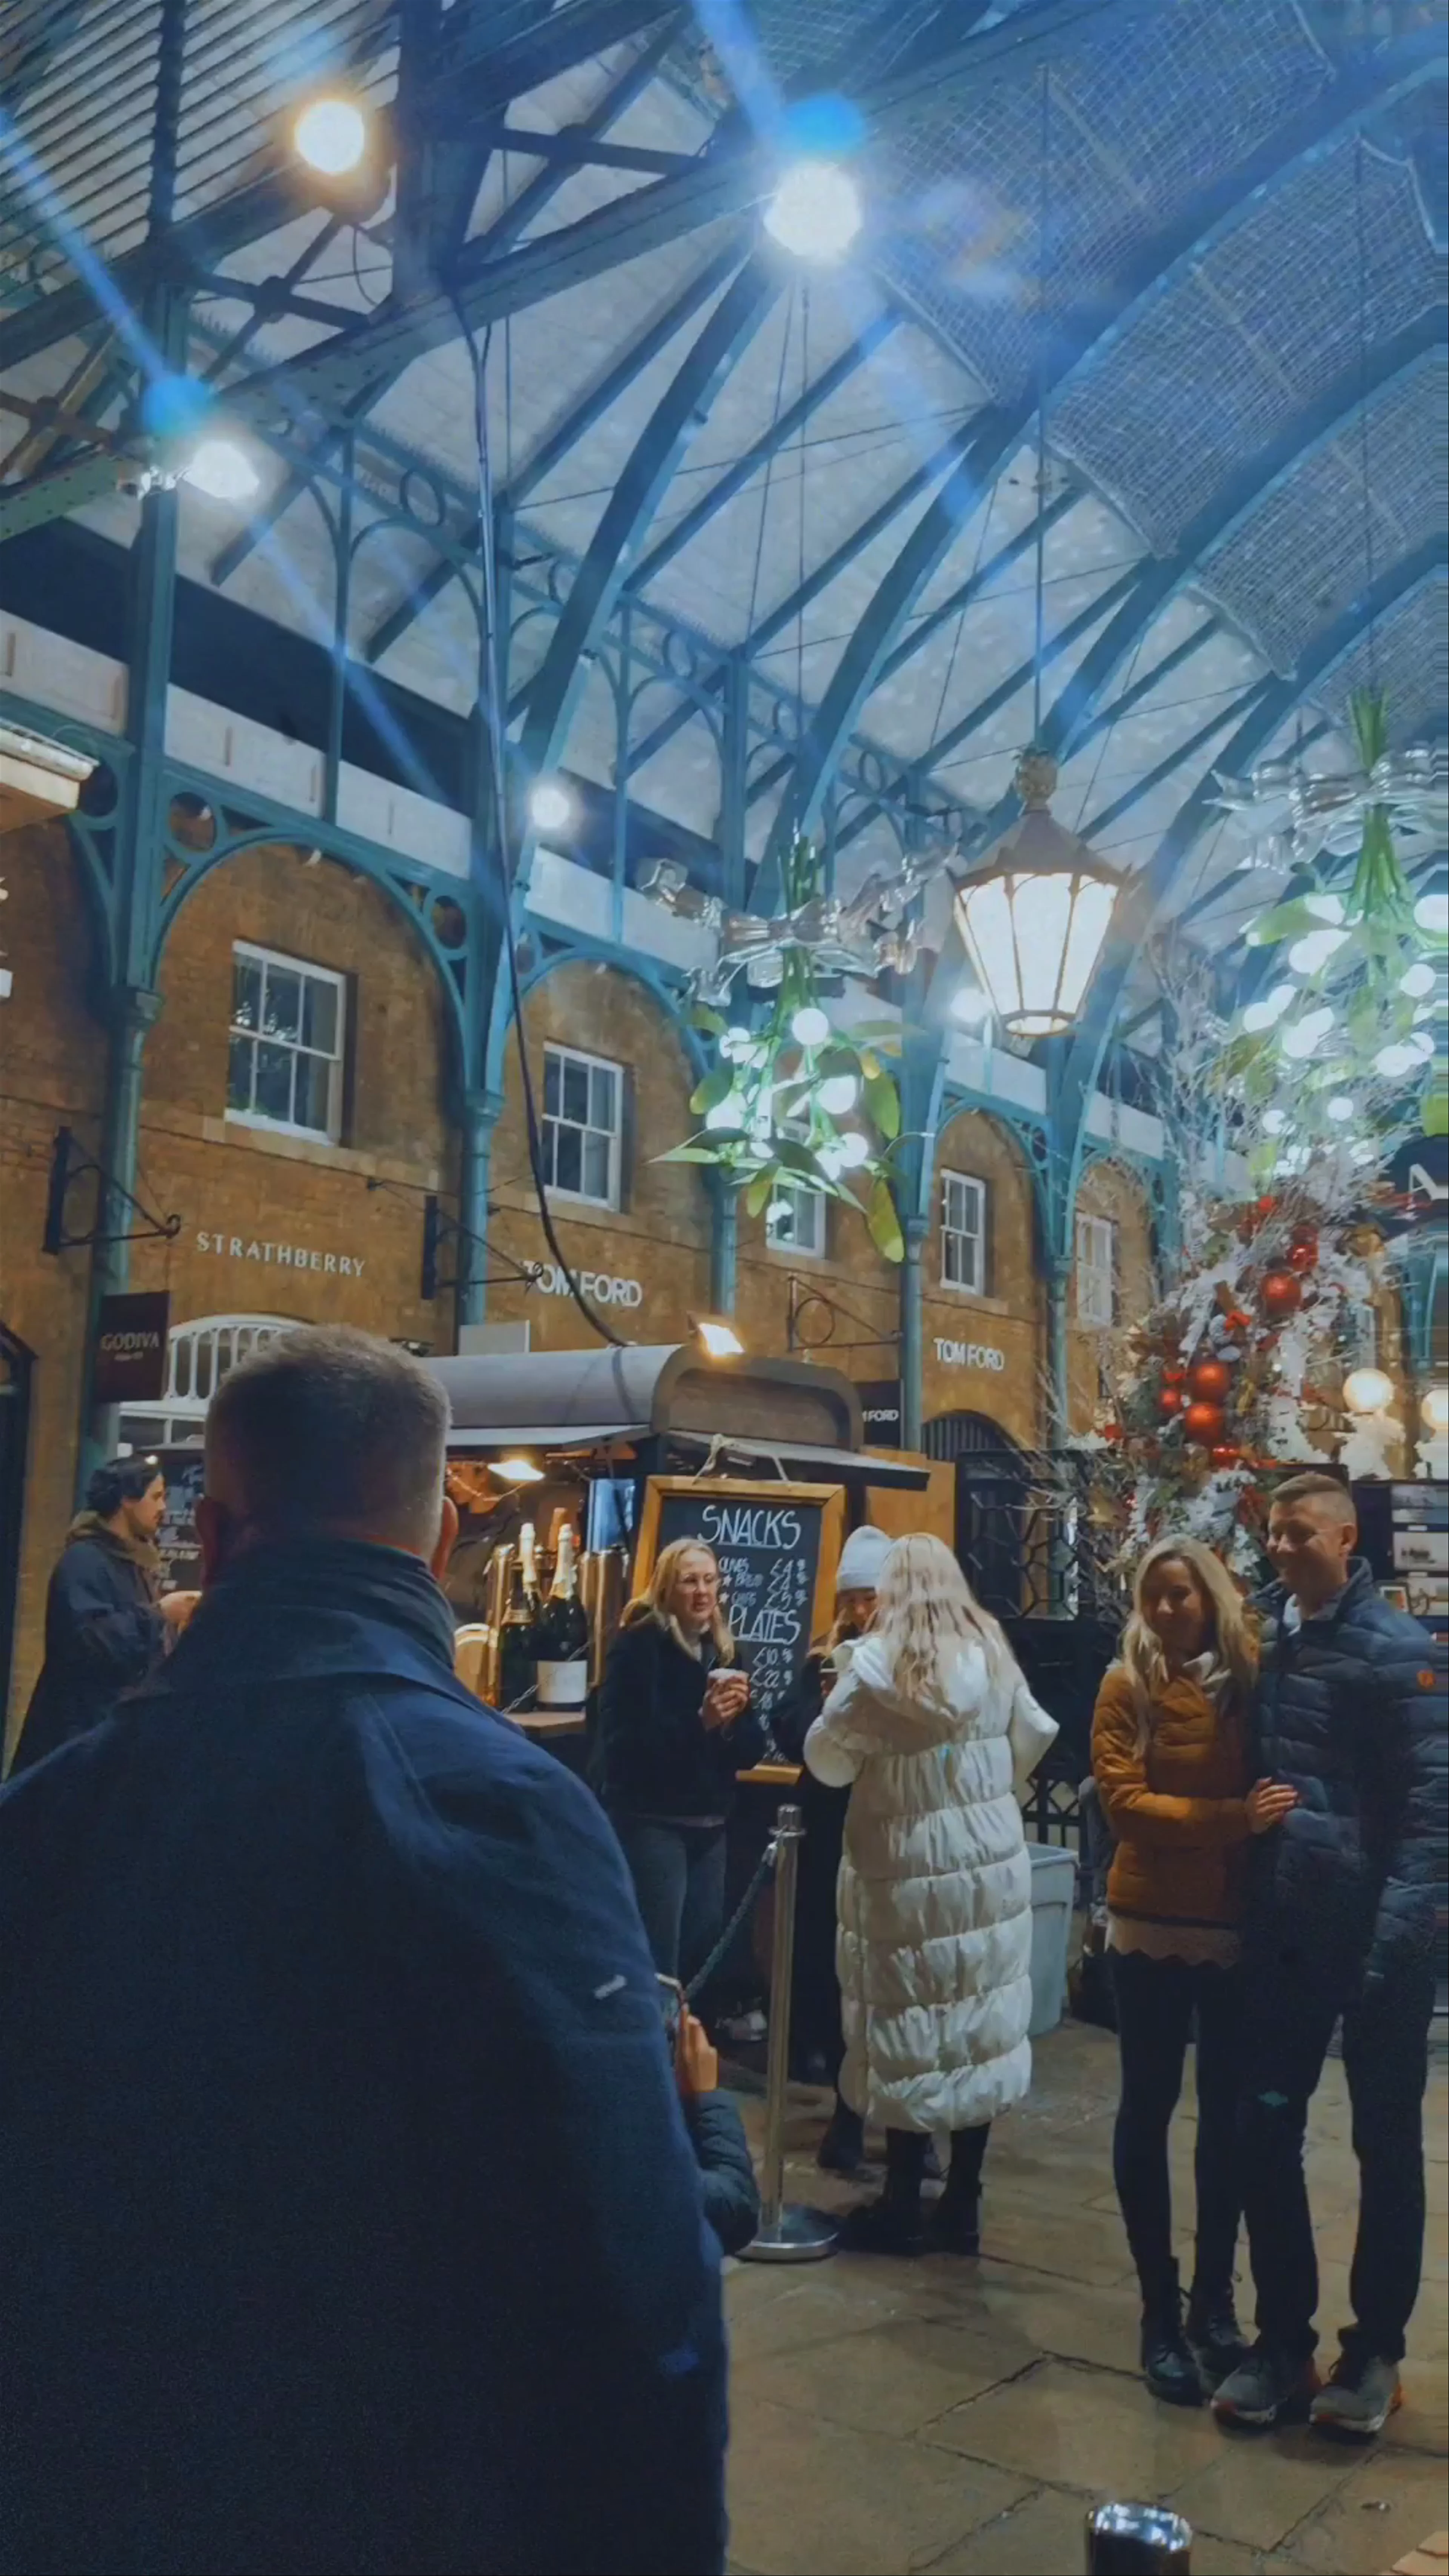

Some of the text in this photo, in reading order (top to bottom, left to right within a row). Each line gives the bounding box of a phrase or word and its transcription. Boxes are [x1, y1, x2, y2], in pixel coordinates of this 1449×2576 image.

[197, 1232, 365, 1277] STRATHBERRY
[580, 1270, 643, 1307] FORD
[100, 1332, 160, 1352] GODIVA
[933, 1338, 1004, 1370] TOM FORD
[868, 1410, 899, 1422] FORD
[697, 1504, 801, 1549] SNACKS
[728, 1604, 801, 1645] PLATES
